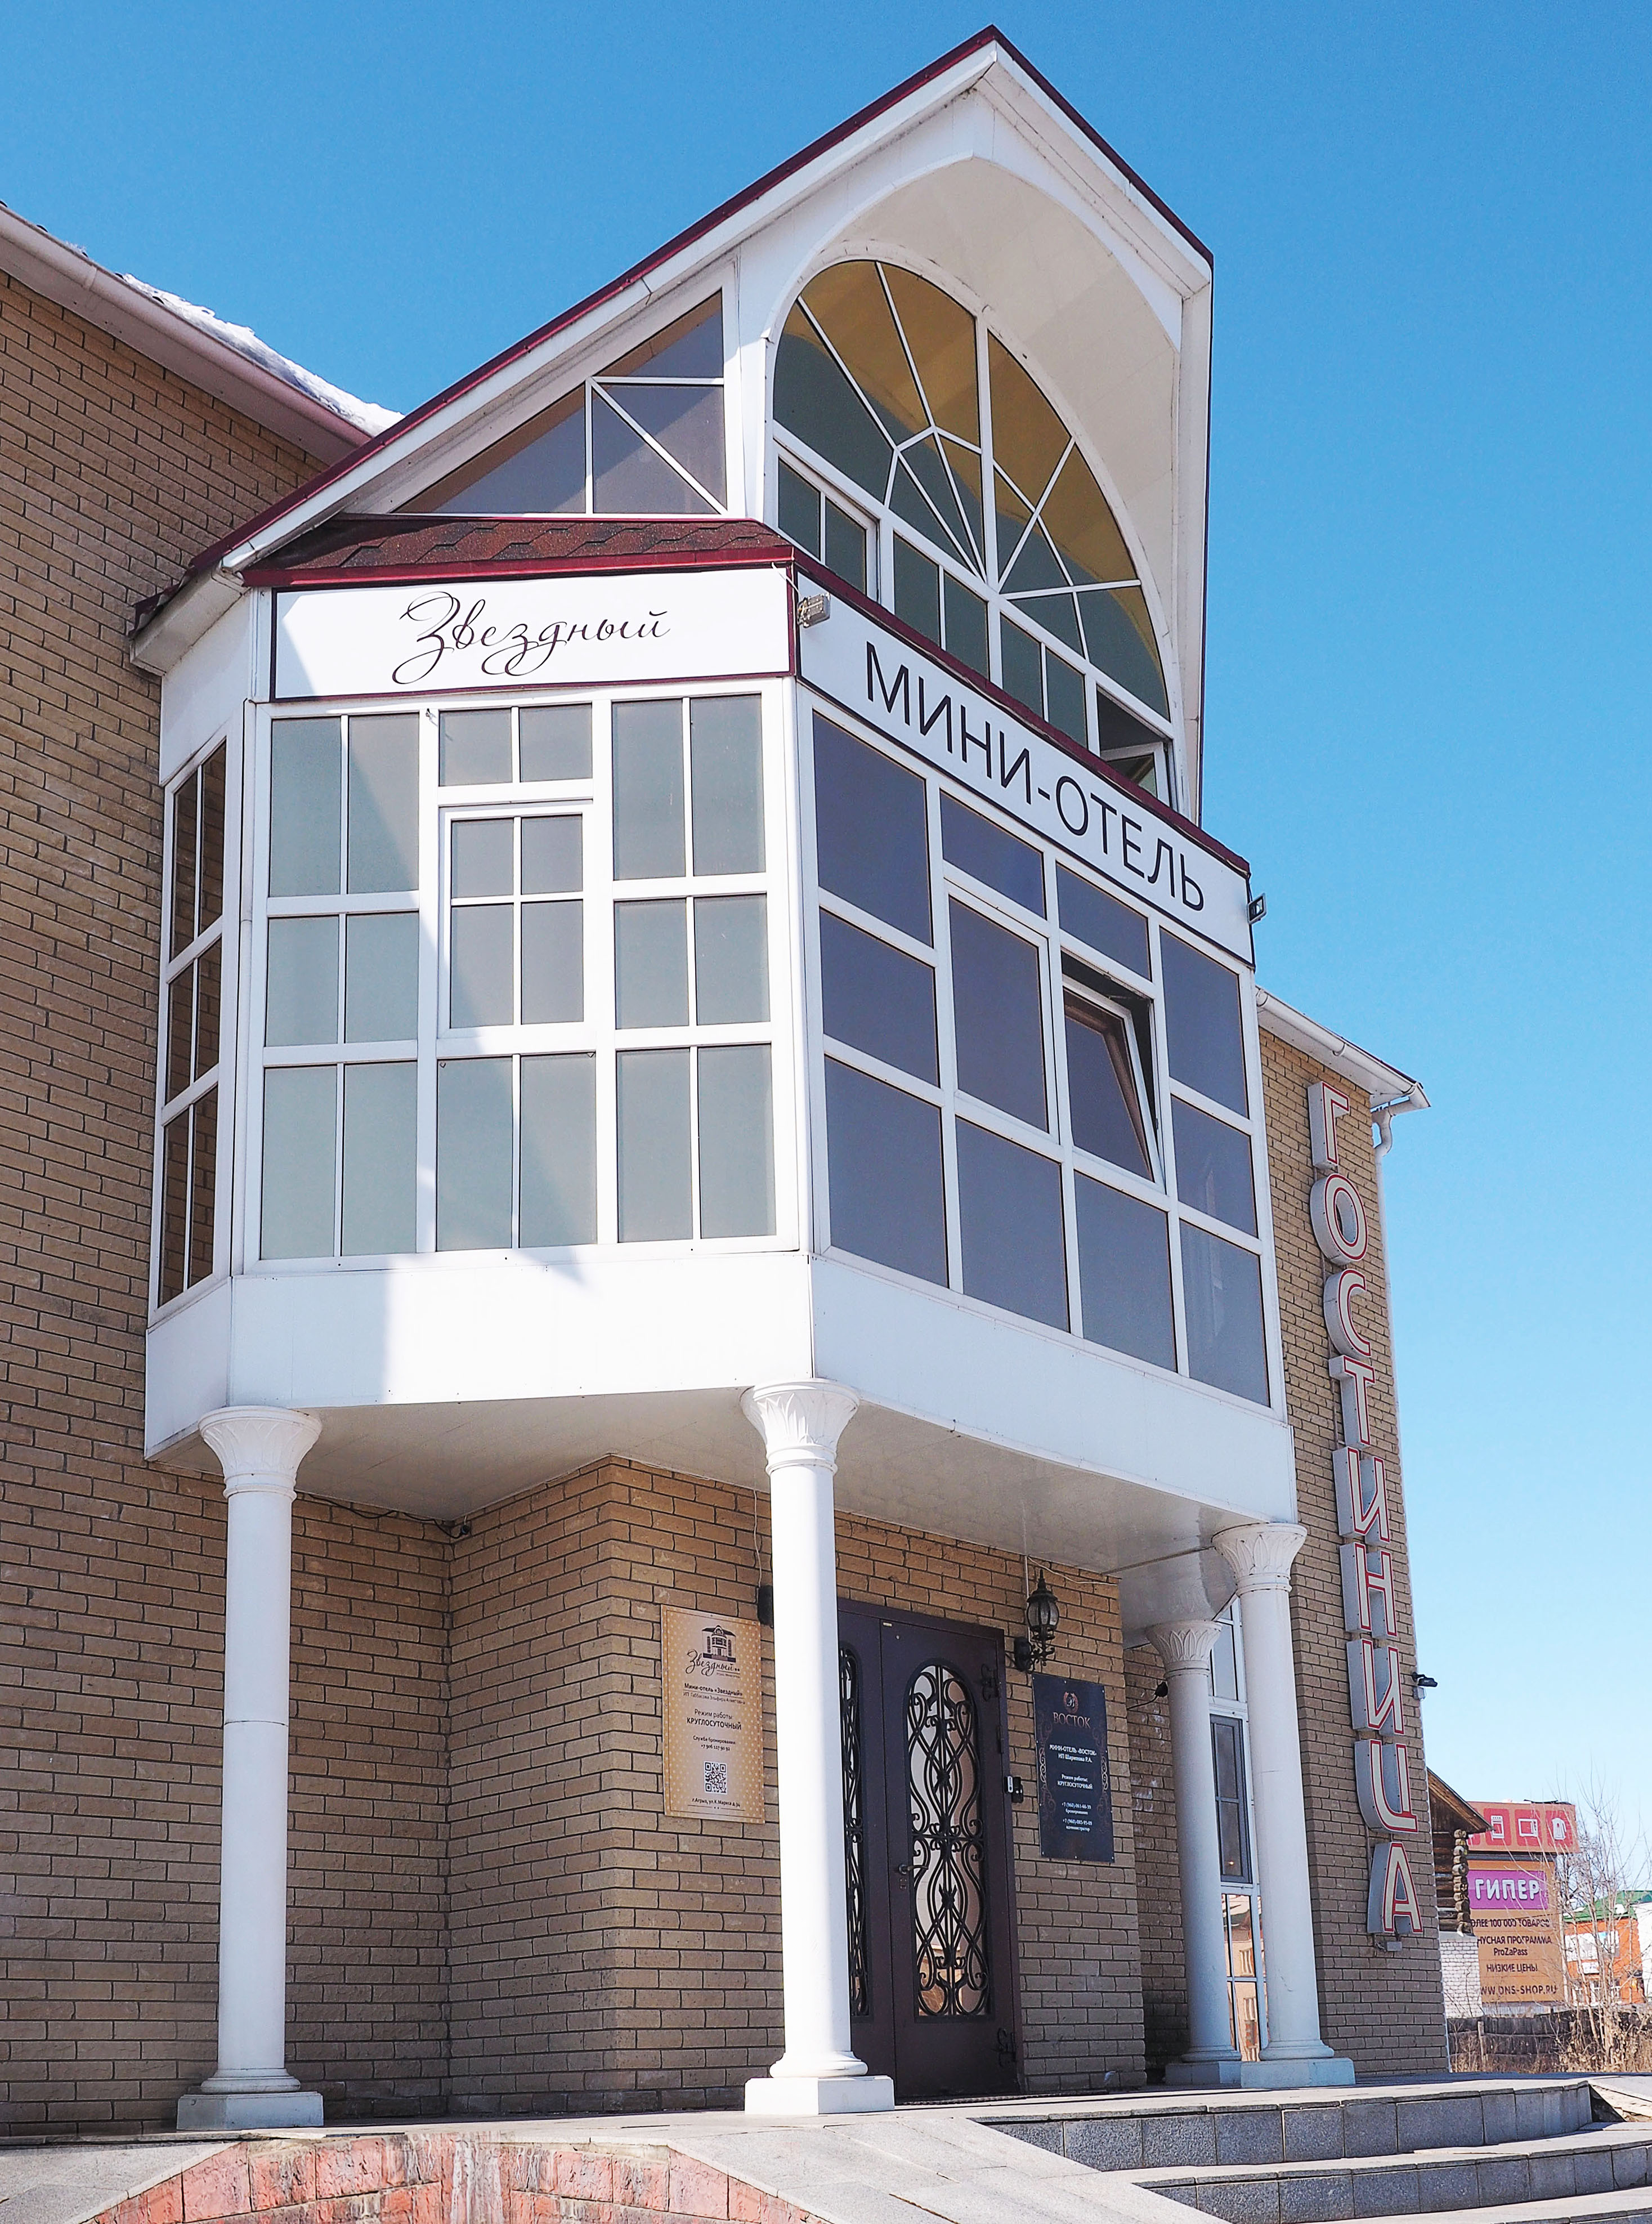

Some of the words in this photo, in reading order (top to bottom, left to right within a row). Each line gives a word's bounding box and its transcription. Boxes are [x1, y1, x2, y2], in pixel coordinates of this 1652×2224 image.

[392, 591, 670, 684] Звездный
[866, 641, 1205, 911] МИНИ-ОТЕЛЬ
[1320, 1081, 1423, 1934] ГОСТИНИЦА
[687, 1717, 742, 1730] КРУГЛОСУТОЧНЫЙ
[1053, 1712, 1091, 1729] ВОСТОК
[1049, 1744, 1077, 1753] МИНИ-ОТЕЛЬ
[1475, 1878, 1539, 1900] ГИПЕР
[1471, 1918, 1489, 1927] ОЛЕЕ
[1490, 1918, 1502, 1927] 100
[1478, 1936, 1506, 1944] НУСНАЯ
[1507, 1936, 1552, 1944] ПРОГРАММА
[1494, 1948, 1528, 1956] ProZaPass
[1487, 1963, 1515, 1972] НИЗКИЕ
[1480, 1985, 1557, 1995] WW.DNS-SHOP.RU
